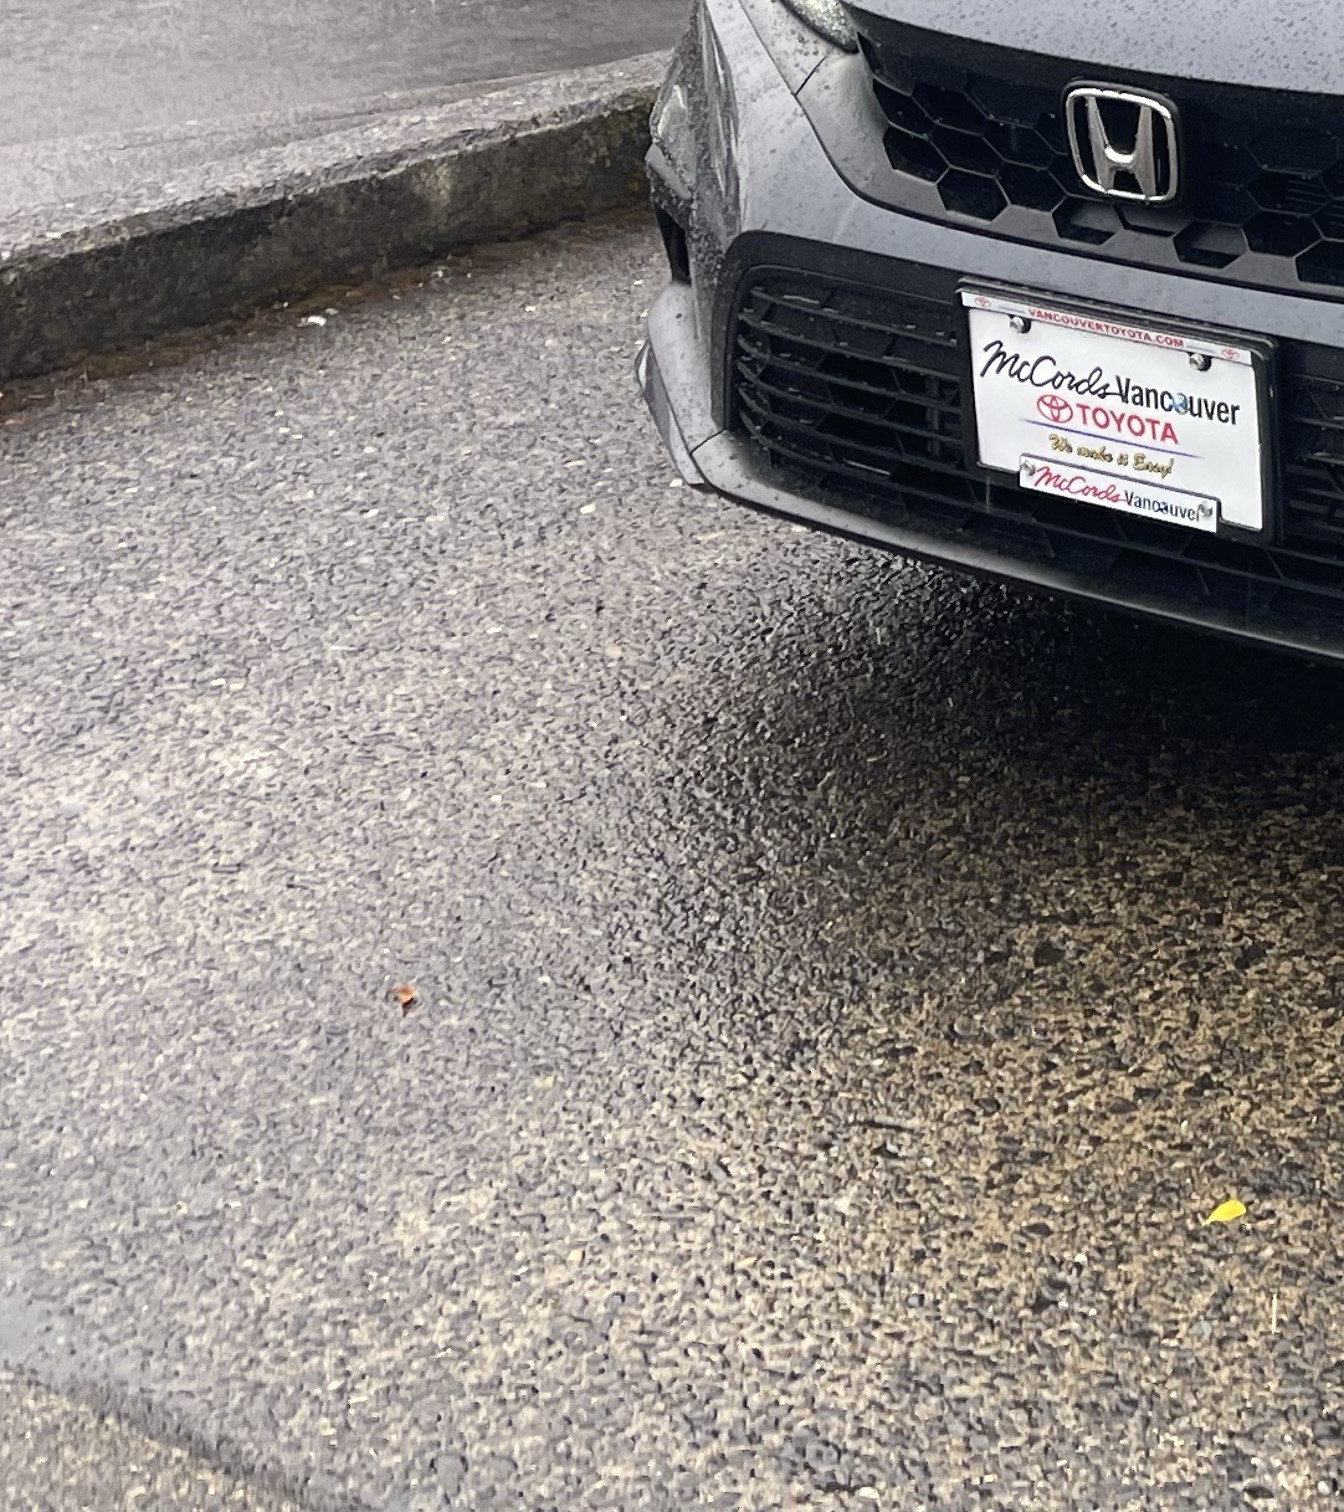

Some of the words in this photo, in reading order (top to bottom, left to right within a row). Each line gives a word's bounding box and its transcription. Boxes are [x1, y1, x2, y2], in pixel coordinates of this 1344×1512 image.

[1076, 404, 1180, 445] TOYOTA
[1049, 433, 1073, 454] We
[1076, 445, 1113, 463] make
